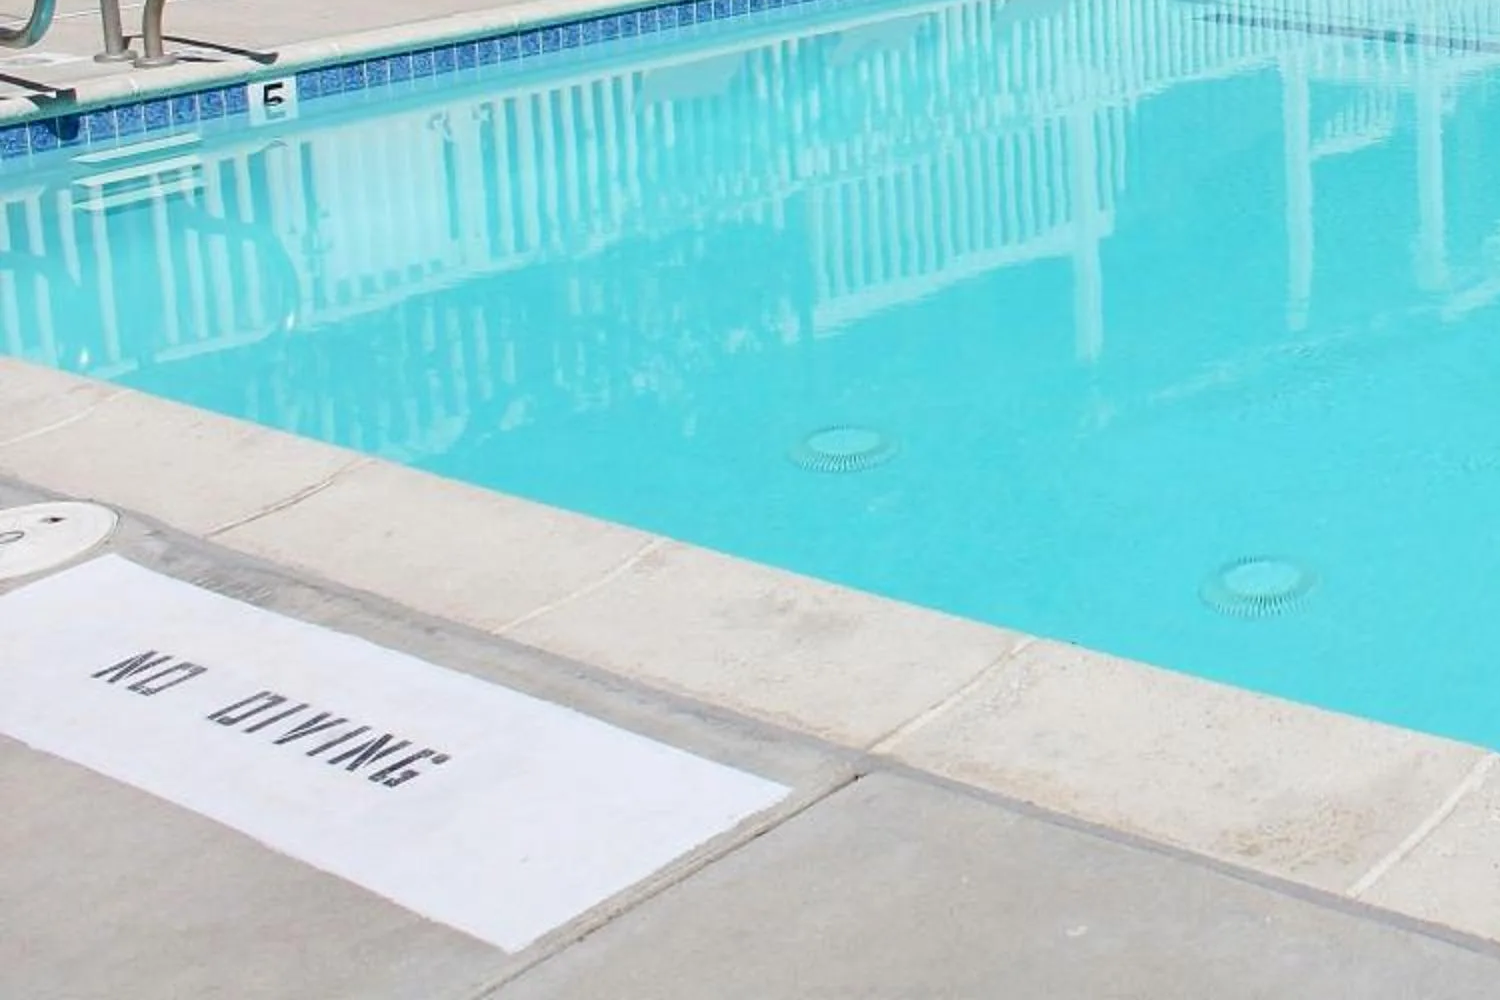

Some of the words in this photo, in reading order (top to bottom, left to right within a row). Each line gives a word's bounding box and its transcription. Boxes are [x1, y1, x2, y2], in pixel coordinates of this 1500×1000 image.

[264, 82, 284, 107] 5
[91, 650, 208, 697] NO
[206, 690, 451, 788] DIVING
